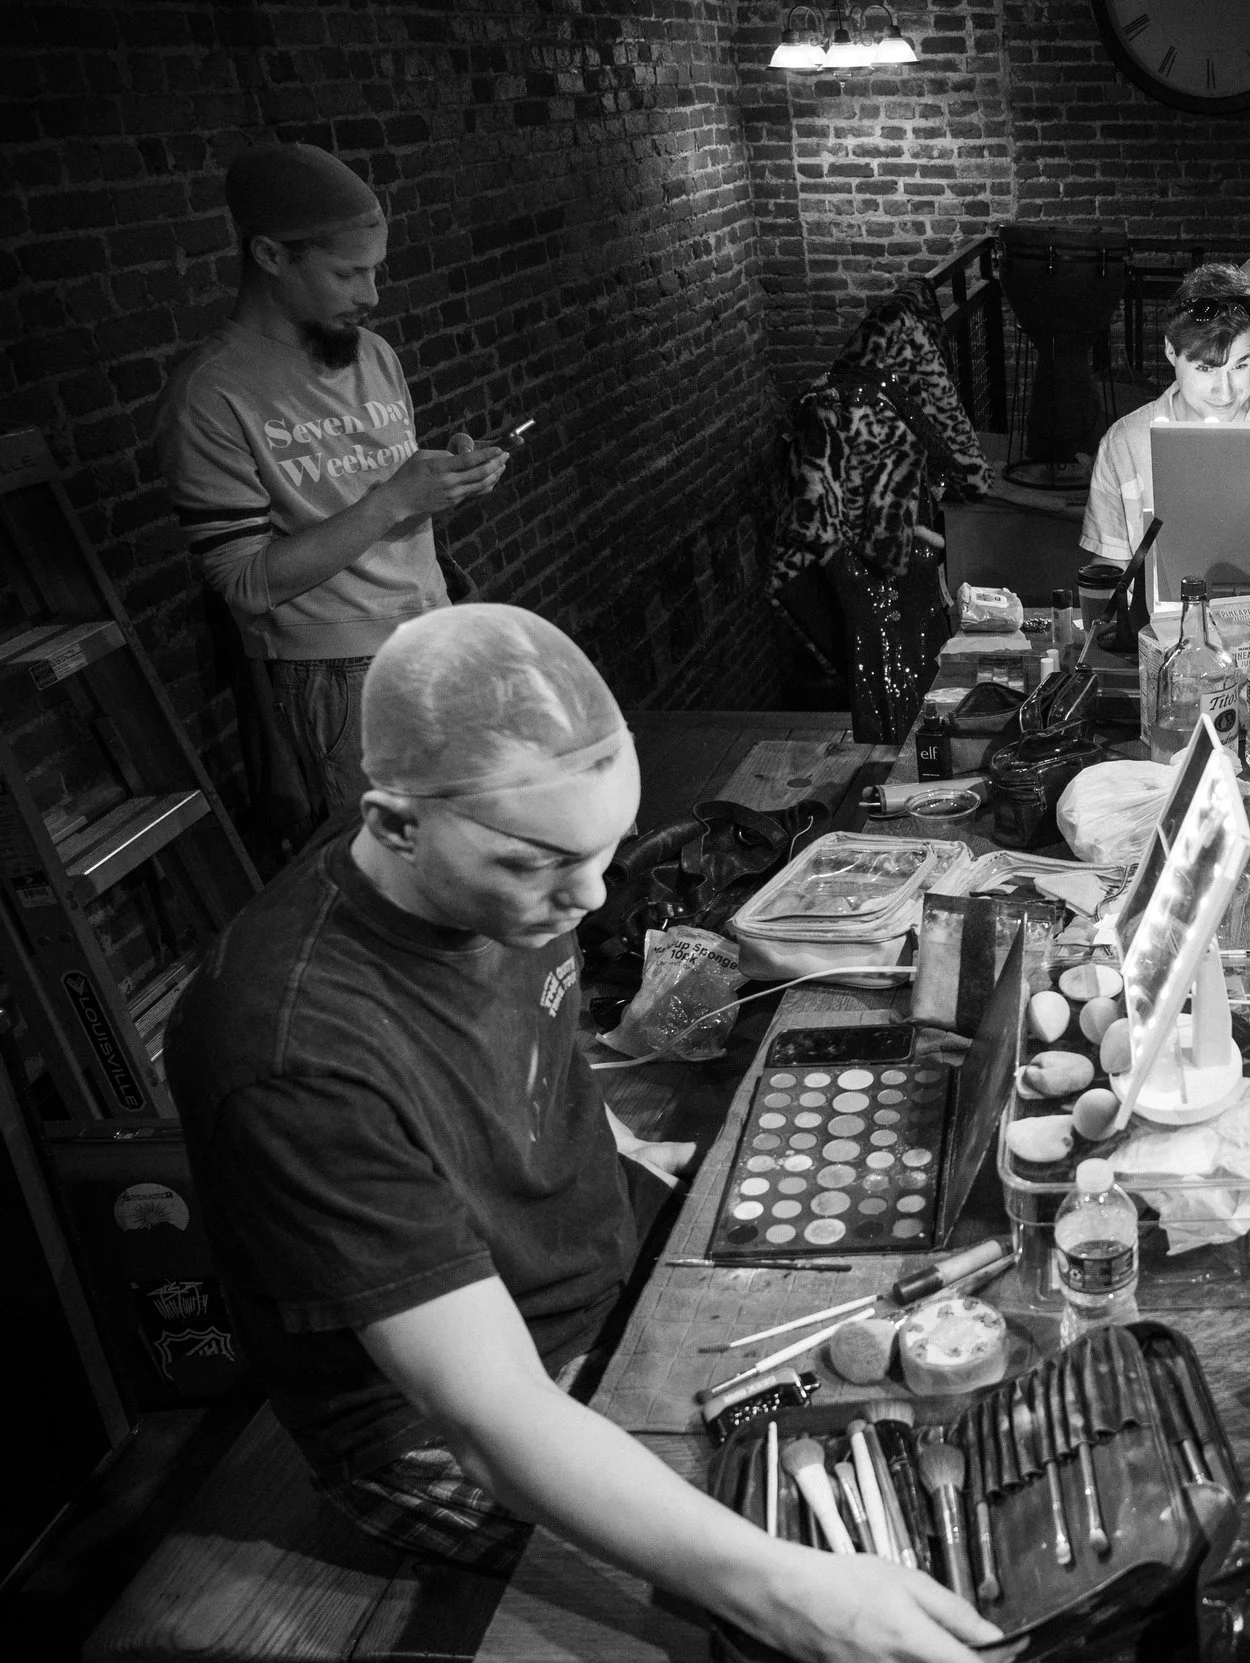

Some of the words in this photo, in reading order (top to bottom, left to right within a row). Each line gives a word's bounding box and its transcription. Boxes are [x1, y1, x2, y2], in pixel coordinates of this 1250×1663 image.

[264, 415, 366, 451] Seven
[361, 400, 411, 431] Day
[278, 430, 419, 488] Weekend
[692, 942, 738, 971] Sponge
[79, 995, 140, 1108] LOUISVILLE
